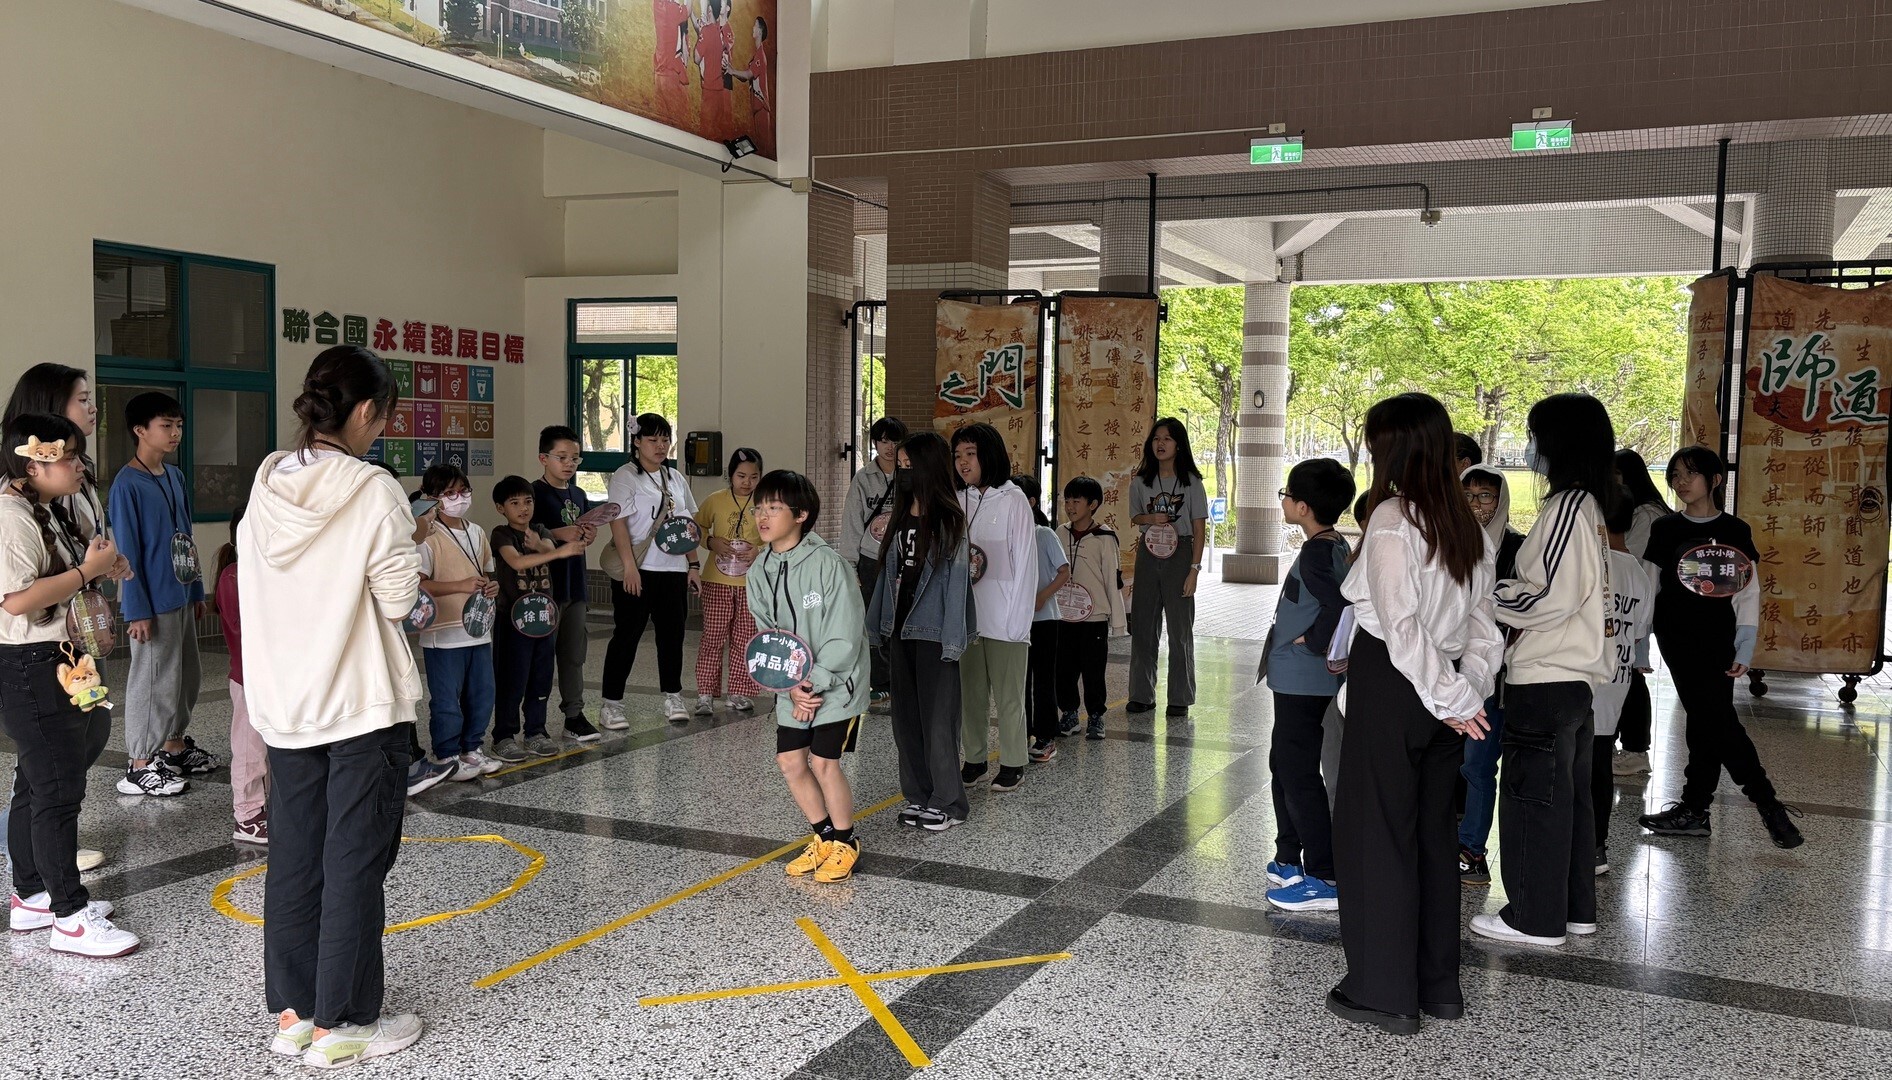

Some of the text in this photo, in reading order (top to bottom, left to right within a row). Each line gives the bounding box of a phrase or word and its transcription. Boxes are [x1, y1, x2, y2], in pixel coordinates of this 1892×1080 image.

[282, 308, 525, 364] 聯合國永續發展目標
[1762, 334, 1889, 422] 師道
[471, 458, 493, 467] GOALS
[1695, 549, 1736, 559] 第六小隊
[1697, 563, 1736, 578] 高玥
[82, 613, 108, 634] 歪歪
[762, 633, 799, 650] 第一小隊
[754, 651, 800, 676] 陳品耀
